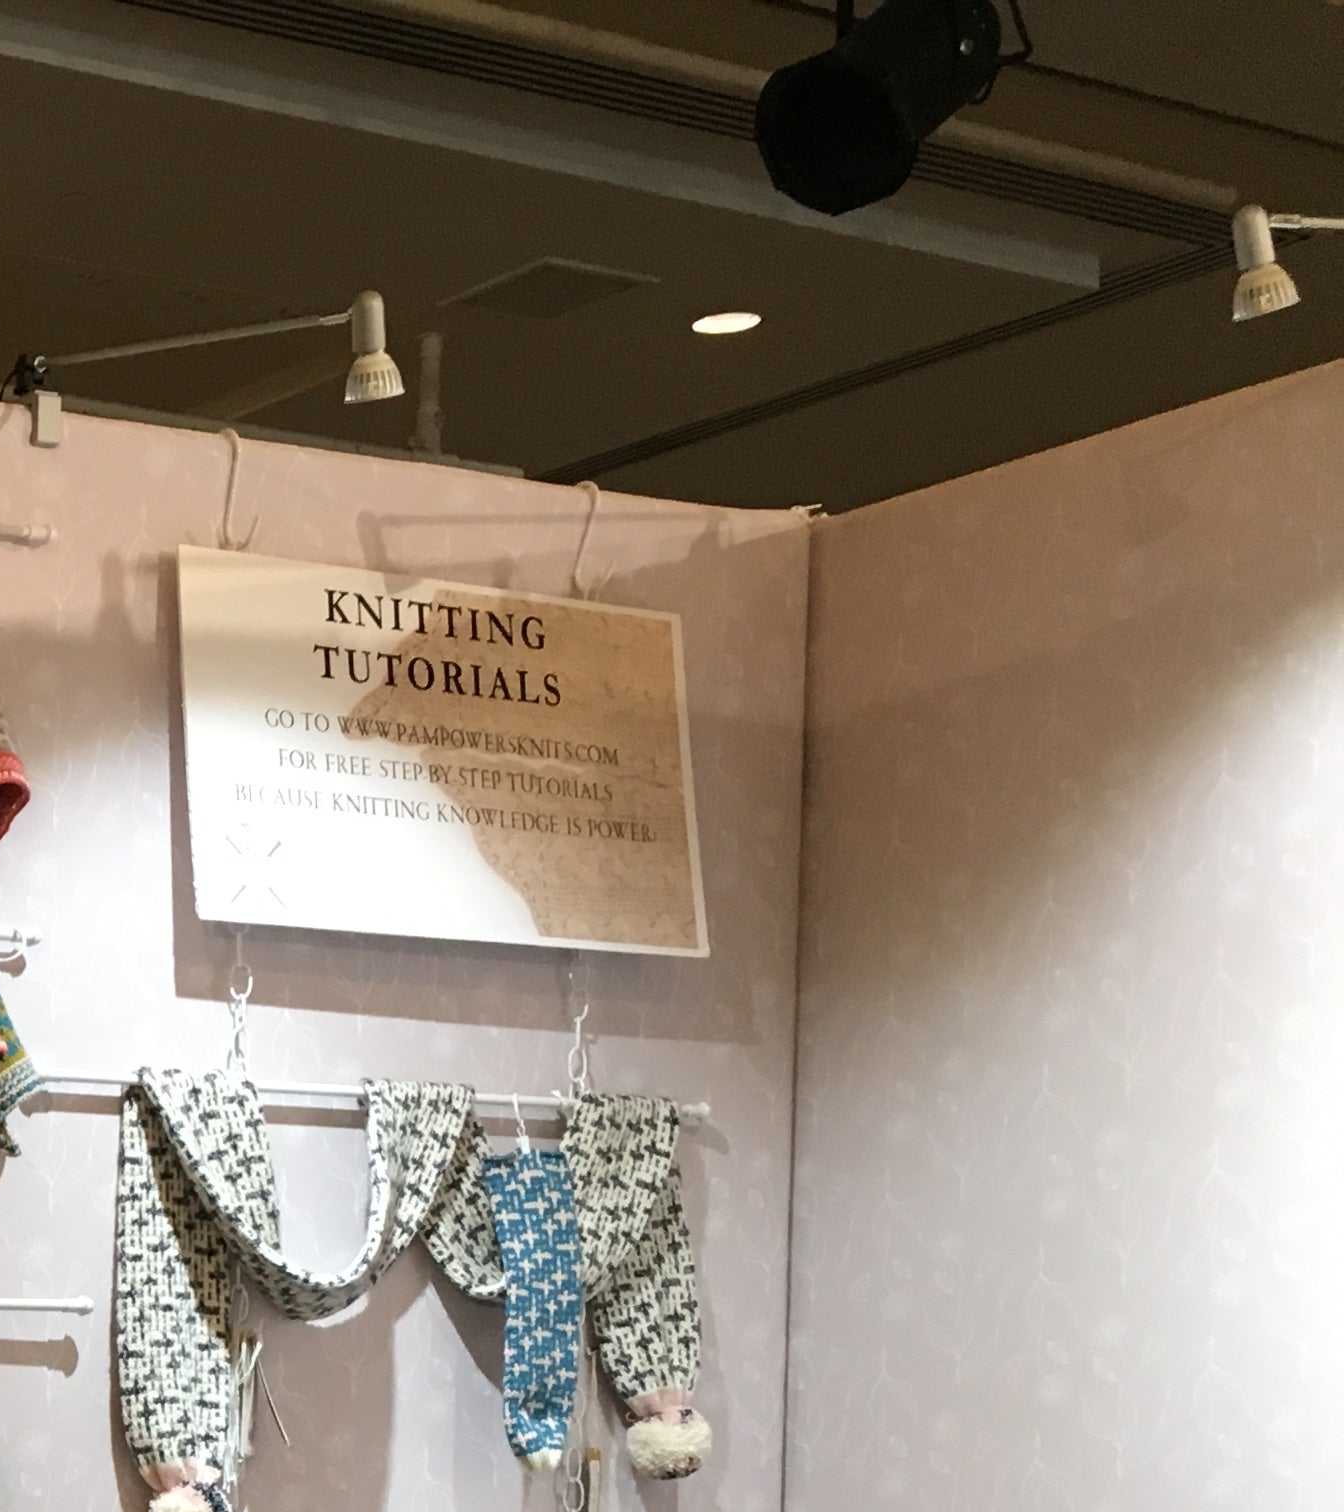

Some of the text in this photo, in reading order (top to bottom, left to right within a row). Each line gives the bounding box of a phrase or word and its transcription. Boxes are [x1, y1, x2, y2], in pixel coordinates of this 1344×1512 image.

[323, 588, 547, 651] KNITTING
[312, 645, 562, 706] TUTORIALS
[264, 708, 295, 729] GO
[301, 711, 330, 733] TO
[278, 748, 317, 771] FOR
[325, 752, 372, 776] FREE
[506, 771, 613, 801] TUTORIALS
[235, 783, 323, 810] BECAUSE
[332, 792, 430, 822] KNITTING
[437, 803, 559, 835] KNOWLEDGE
[566, 816, 582, 836] IS
